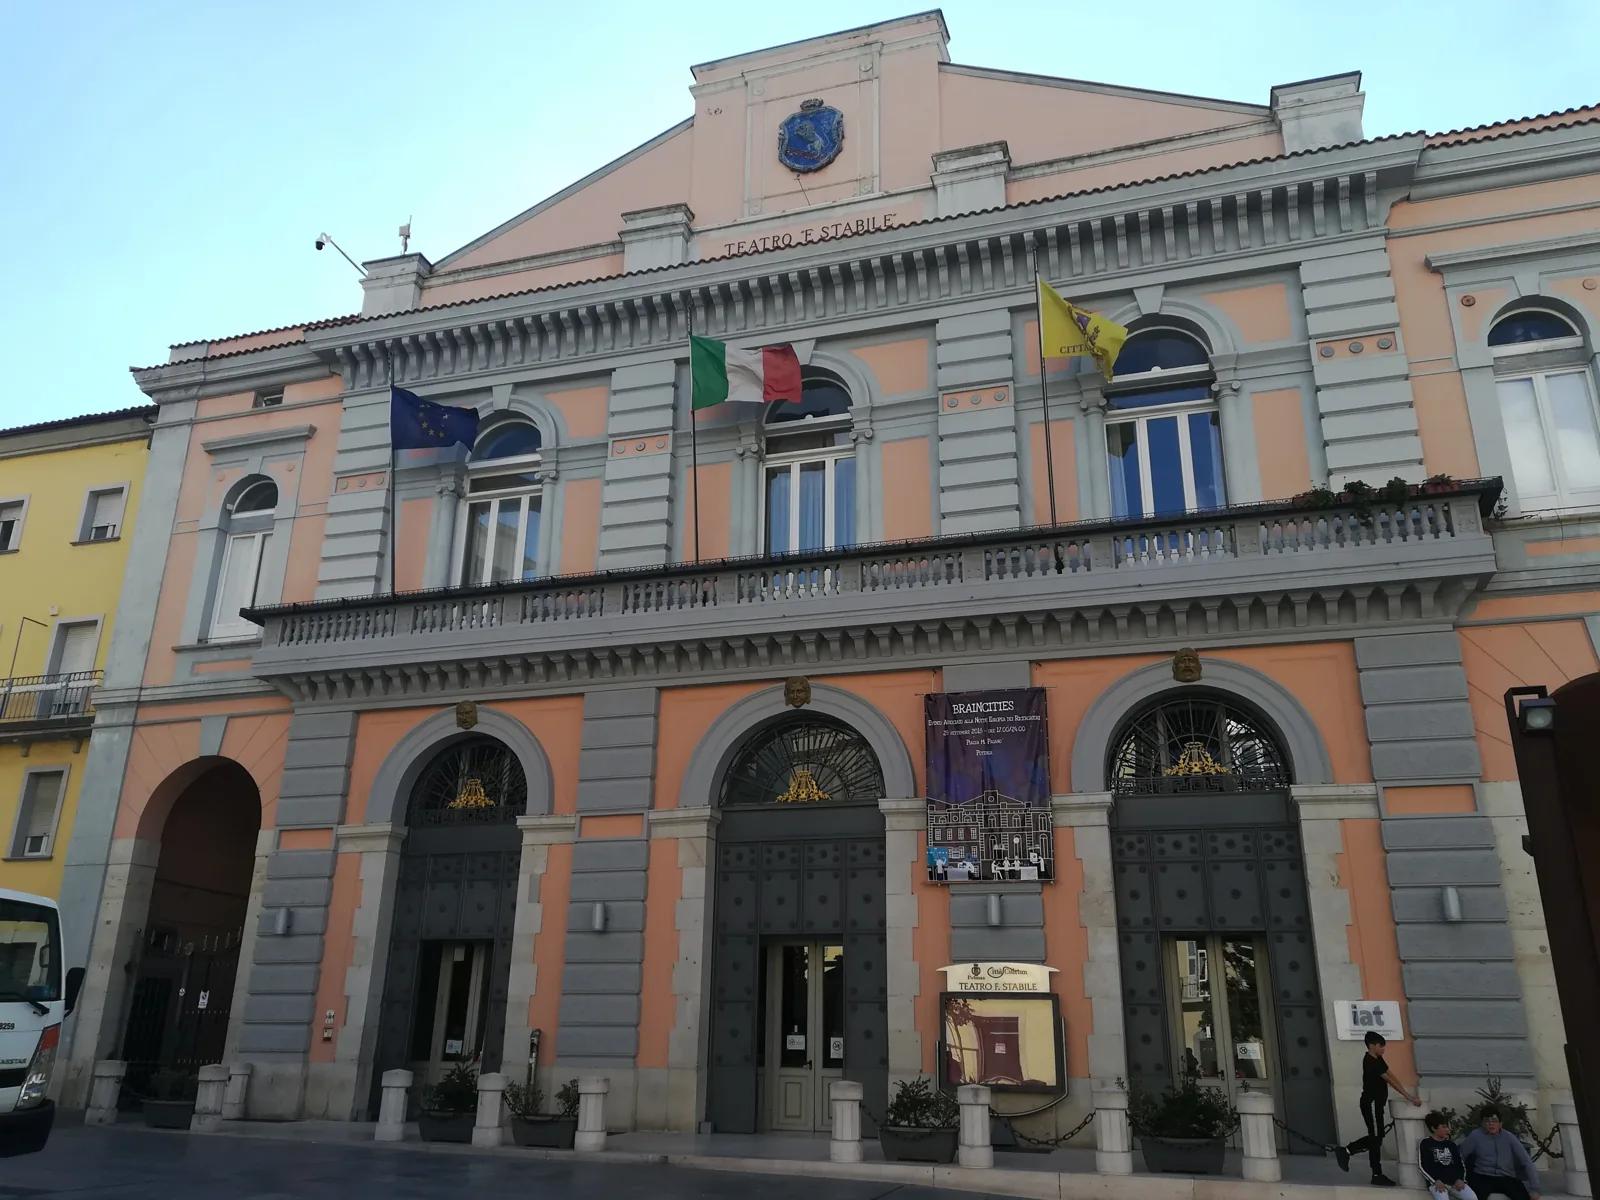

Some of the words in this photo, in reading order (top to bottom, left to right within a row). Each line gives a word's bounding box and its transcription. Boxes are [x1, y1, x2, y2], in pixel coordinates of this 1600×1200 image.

[724, 233, 793, 256] TEATRO
[952, 701, 1014, 714] BRAINCITIES
[959, 982, 993, 991] TEATRO
[994, 982, 1001, 991] F.
[1002, 982, 1038, 991] STABILE
[1351, 1004, 1385, 1026] iat
